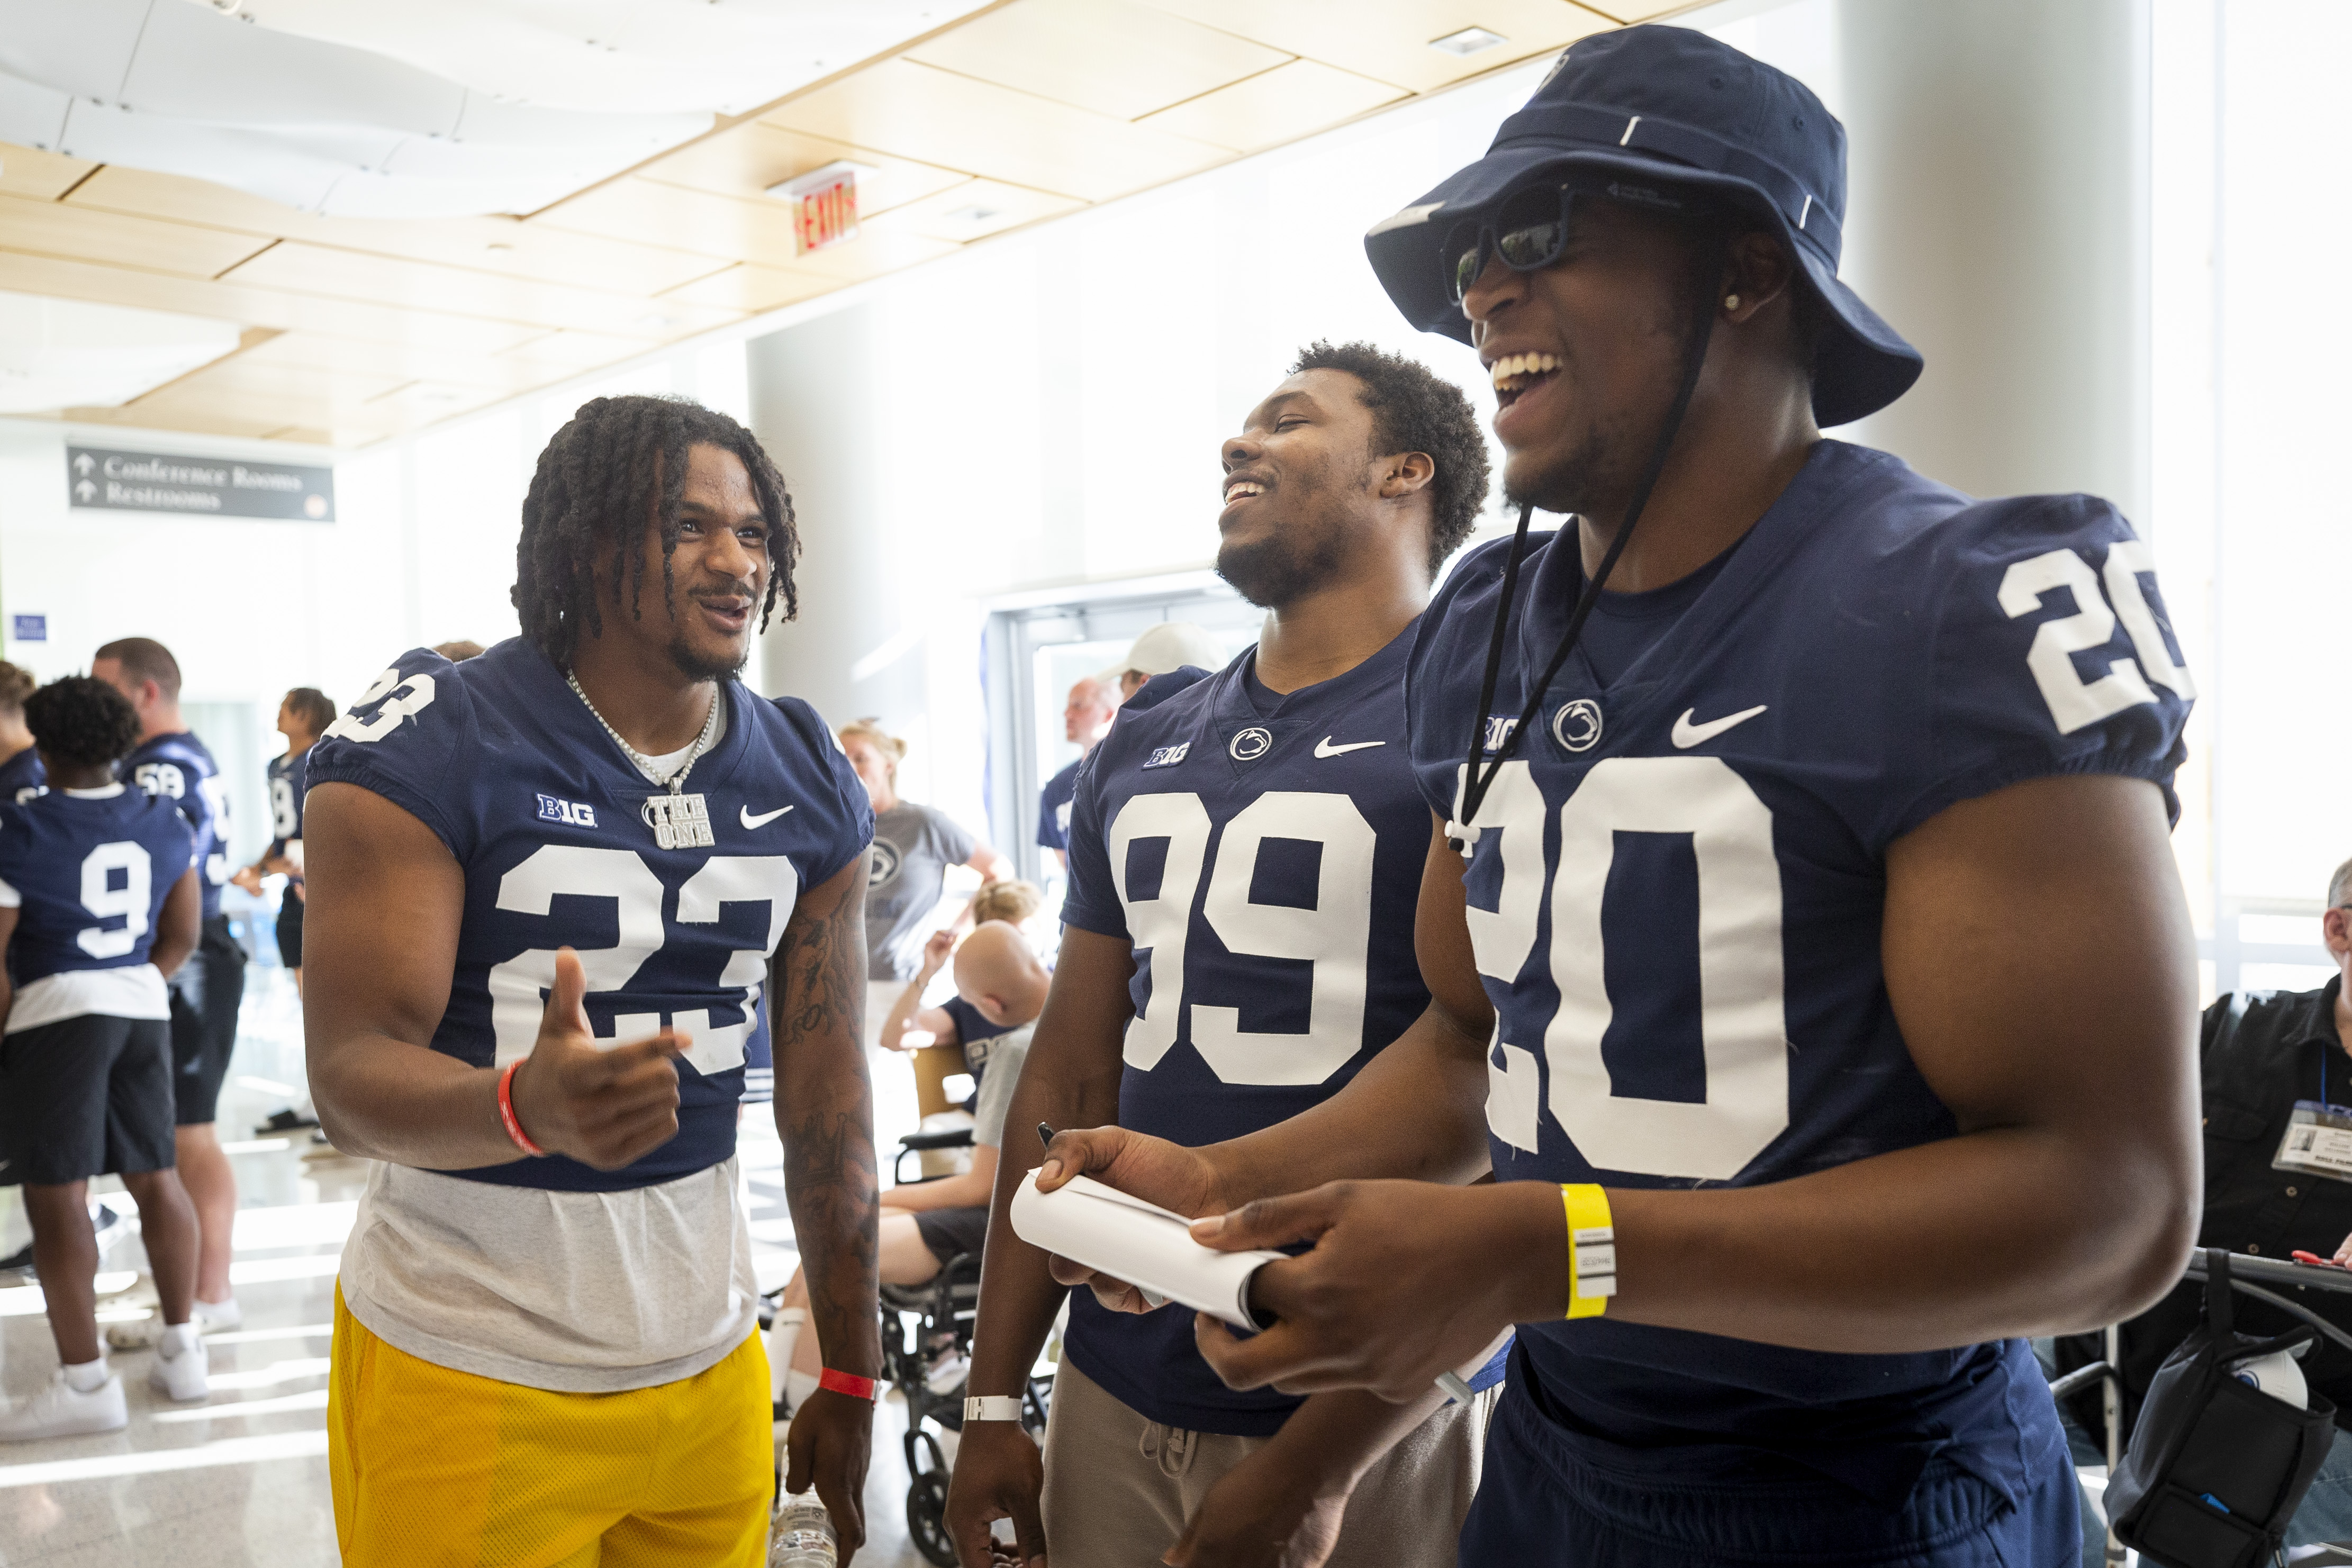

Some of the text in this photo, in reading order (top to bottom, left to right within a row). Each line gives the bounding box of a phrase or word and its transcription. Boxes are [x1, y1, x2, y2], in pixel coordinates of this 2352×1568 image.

[104, 456, 304, 493] Conference Rooms
[107, 481, 222, 511] Restrooms
[647, 794, 709, 823] THE
[654, 820, 715, 849] ONE
[77, 840, 152, 959] 9
[1110, 791, 1377, 1085] 99
[488, 844, 798, 1076] 23
